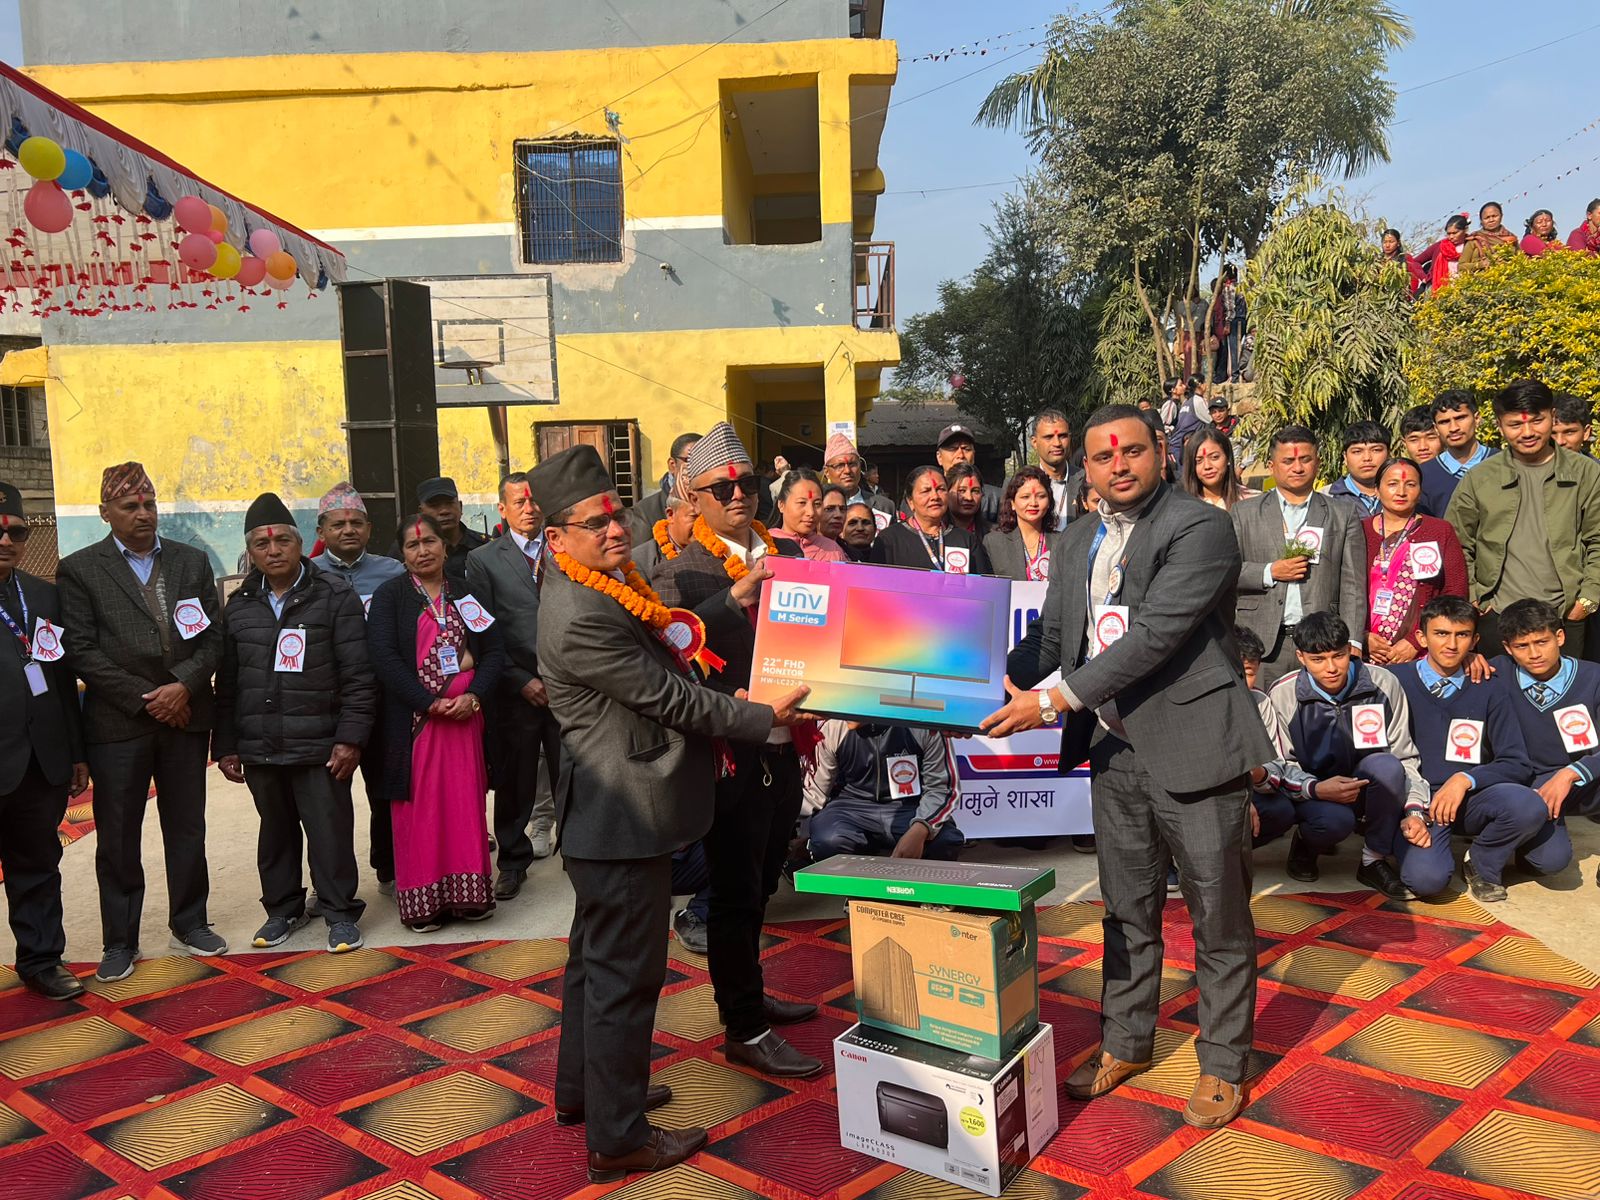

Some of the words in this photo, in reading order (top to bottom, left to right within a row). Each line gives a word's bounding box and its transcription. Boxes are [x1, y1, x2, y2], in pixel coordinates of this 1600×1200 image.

[777, 612, 786, 621] M
[789, 614, 819, 624] Series
[783, 660, 805, 669] FHD
[762, 667, 804, 677] MONITOR
[960, 785, 1000, 816] ामुने
[1007, 790, 1055, 809] शाखा
[886, 886, 915, 895] UGREEN
[856, 905, 889, 918] COMPUTER
[890, 912, 906, 922] CASE
[928, 964, 981, 985] SYNERGY
[841, 1049, 868, 1063] Canon
[996, 1072, 1012, 1093] Canon
